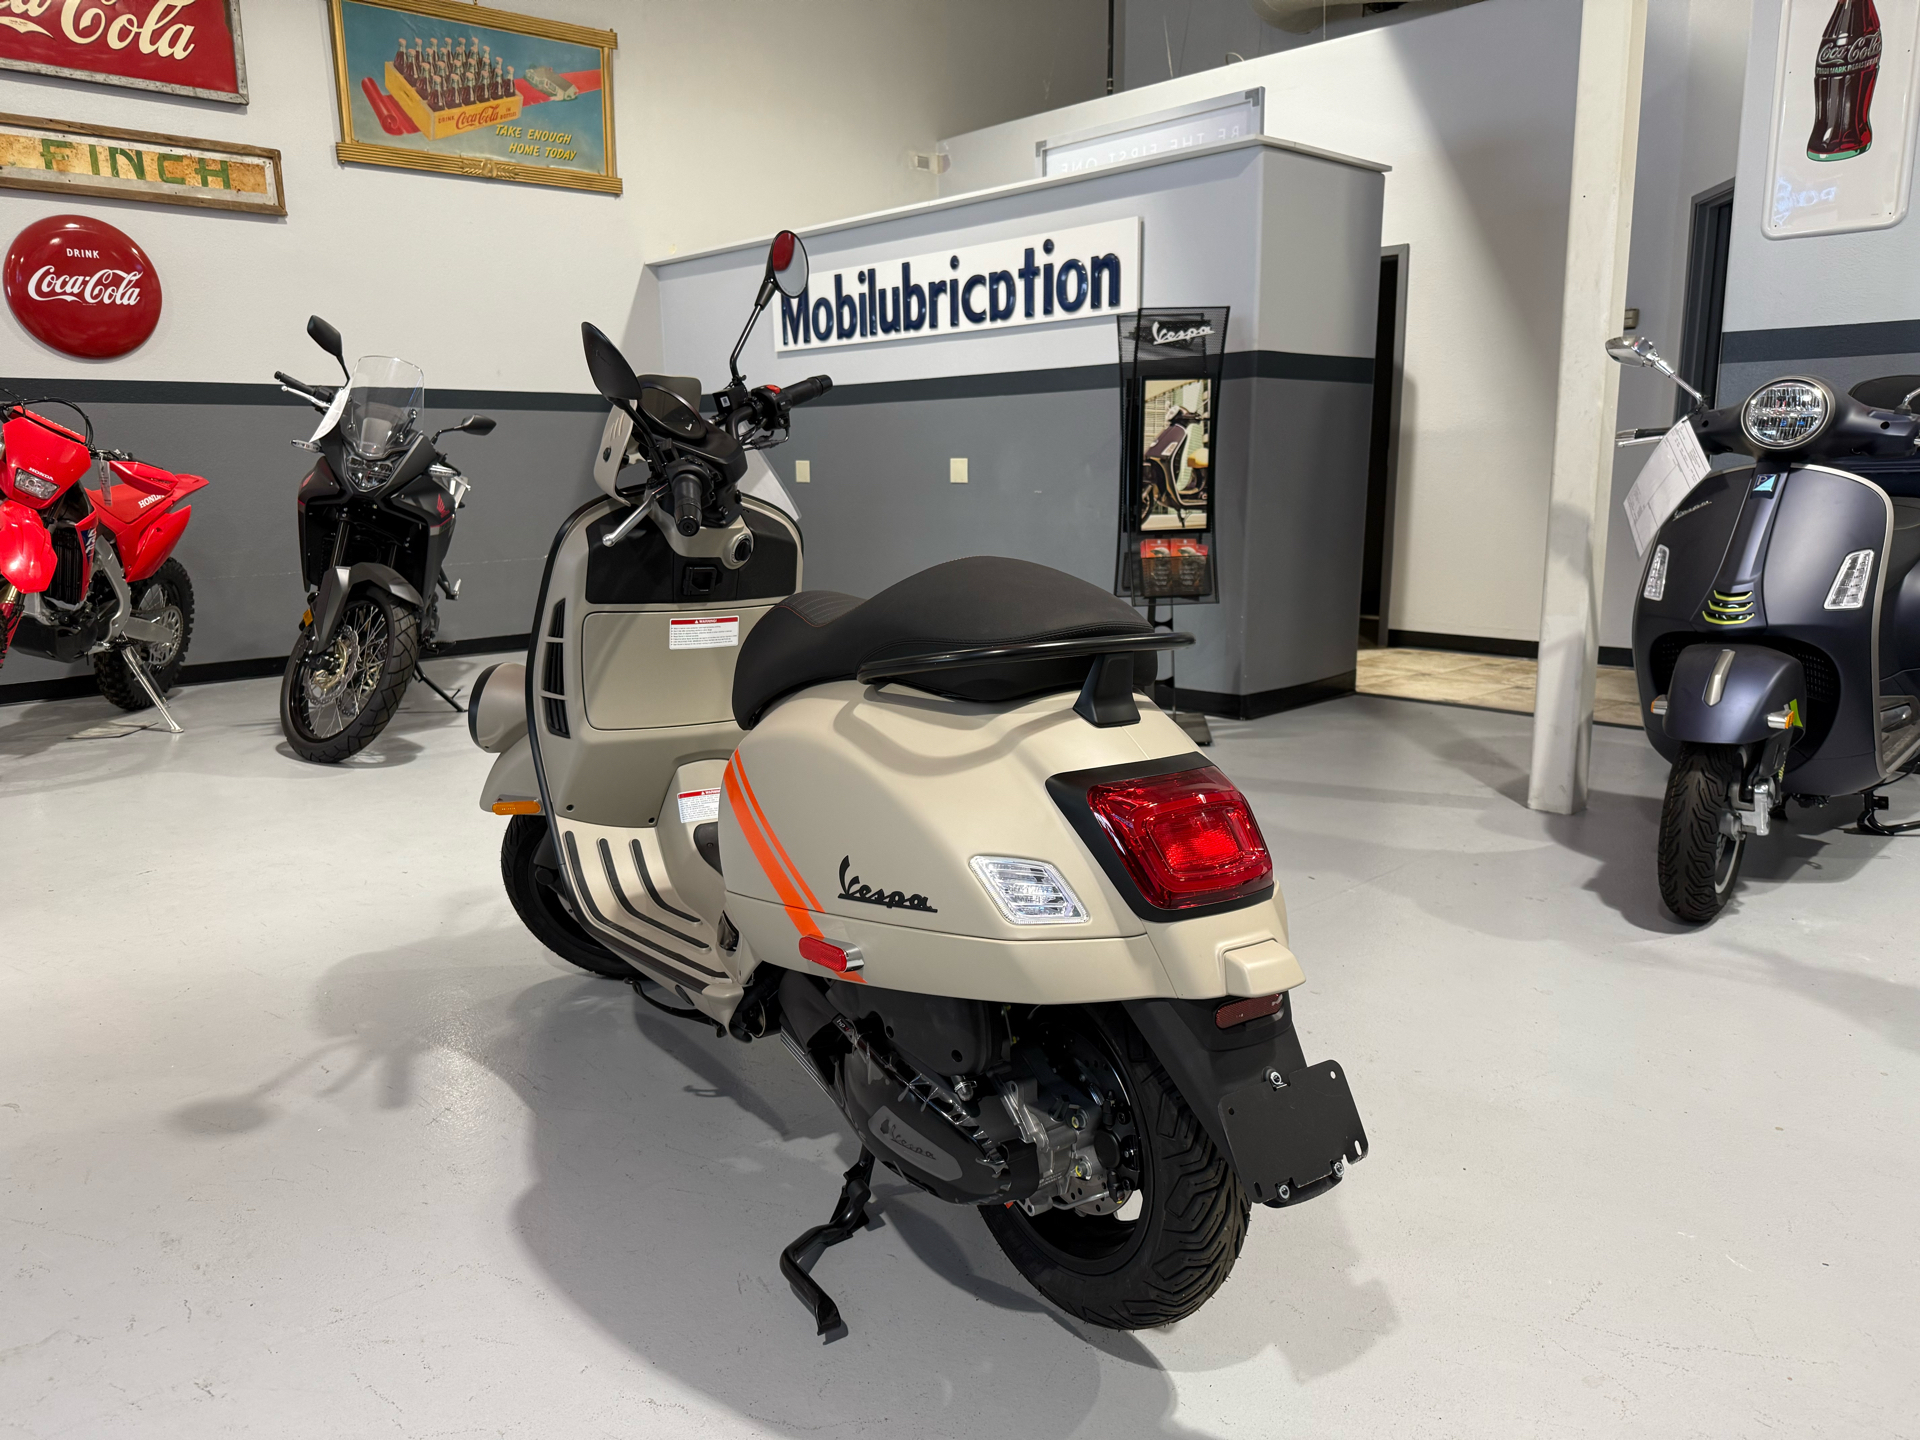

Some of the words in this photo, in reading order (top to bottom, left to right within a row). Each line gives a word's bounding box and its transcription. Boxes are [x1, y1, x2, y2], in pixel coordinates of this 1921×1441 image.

[0, 0, 195, 60] aCola
[1830, 66, 1847, 74] MARK
[438, 115, 455, 124] DRINK
[456, 104, 500, 130] Coca-Cola
[495, 125, 522, 138] TAKE
[527, 129, 572, 145] ENOUGH
[39, 138, 231, 190] FINCH
[508, 142, 540, 157] HOME
[545, 147, 577, 161] TODAY
[66, 248, 100, 259] DRINK
[27, 265, 144, 306] Coca-Cola
[780, 238, 1122, 346] Mobilubrication
[1152, 321, 1215, 345] Vespa
[29, 466, 54, 481] HONDA
[837, 854, 938, 914] Vespa
[890, 1124, 937, 1161] Vespa
